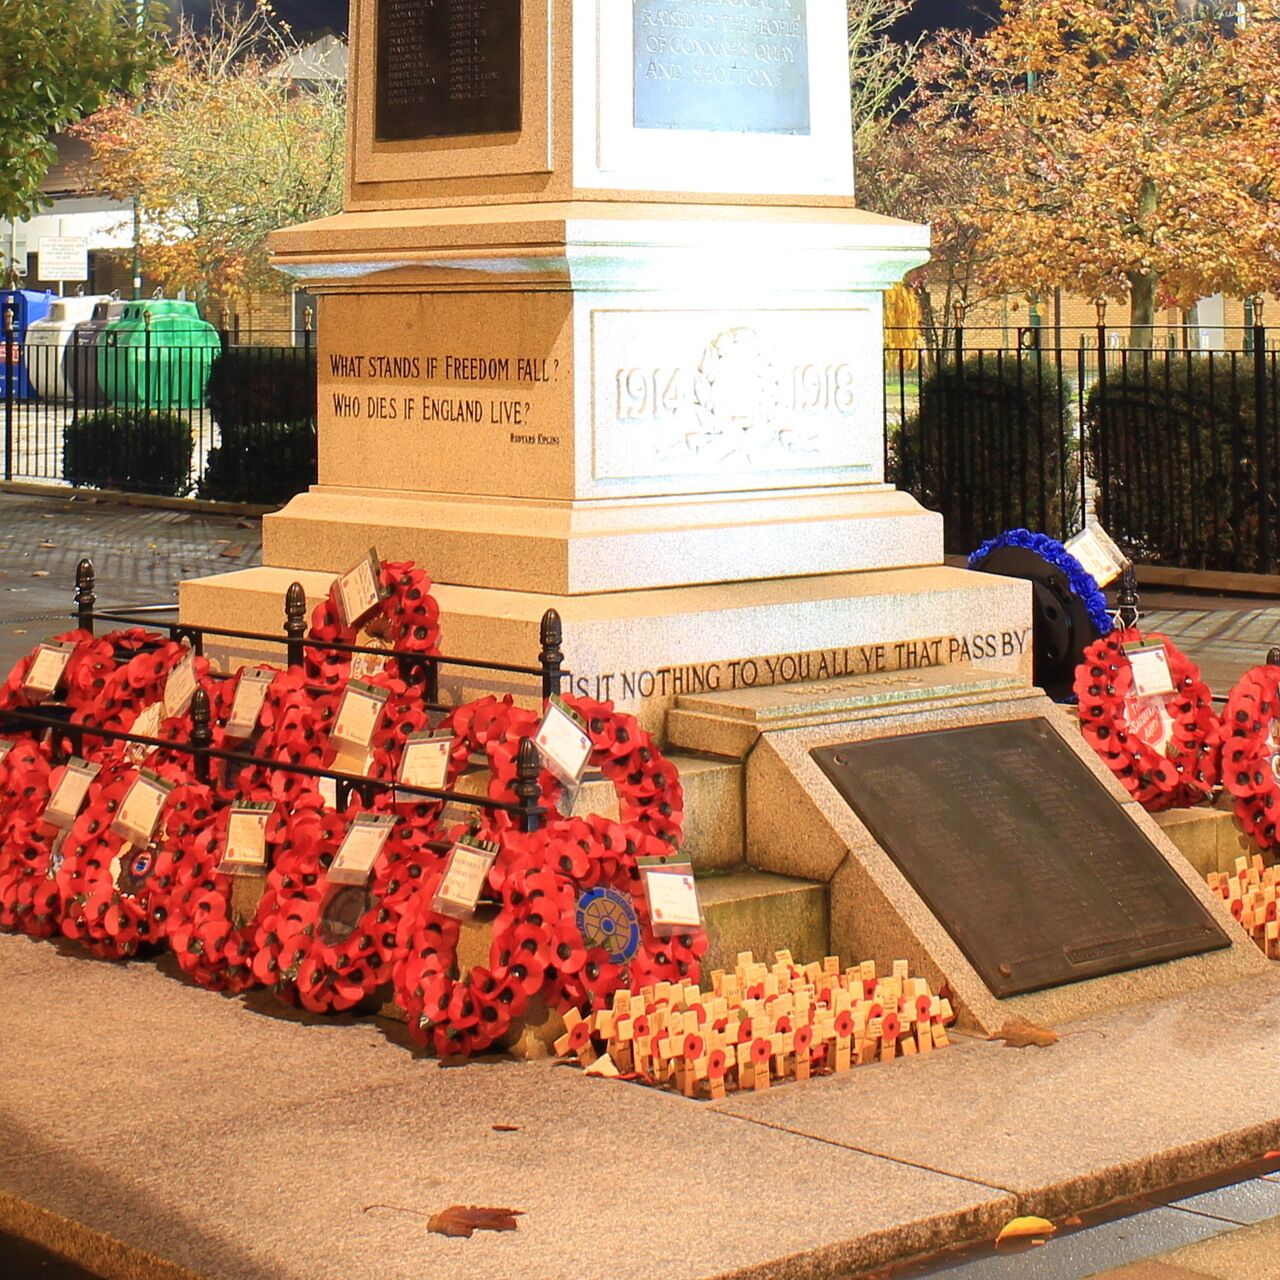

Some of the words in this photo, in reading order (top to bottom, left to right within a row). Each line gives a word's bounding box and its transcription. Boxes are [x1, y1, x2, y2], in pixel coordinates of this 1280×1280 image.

[642, 9, 695, 29] RAISED
[722, 15, 749, 33] THE
[753, 17, 801, 36] PEOPLE
[646, 35, 668, 54] OF
[646, 61, 683, 80] AND
[329, 353, 365, 379] WHAT
[368, 356, 420, 380] STANDS
[426, 357, 439, 380] IF
[445, 355, 510, 382] FREEDOM
[332, 393, 361, 418] WHO
[367, 396, 397, 419] DIES
[404, 398, 415, 421] IF
[422, 396, 483, 424] ENGLAND
[490, 400, 531, 425] LIVE?
[510, 432, 536, 445] RUDYARD
[537, 433, 560, 446] KIPLING
[569, 673, 589, 697] IS
[596, 673, 615, 704] IT
[621, 664, 720, 700] NOTHING
[728, 660, 758, 688] TO
[765, 653, 810, 684] YOU
[817, 649, 854, 681] ALL
[860, 645, 886, 673] YE
[894, 637, 943, 670] THAT
[949, 633, 997, 663] PASS
